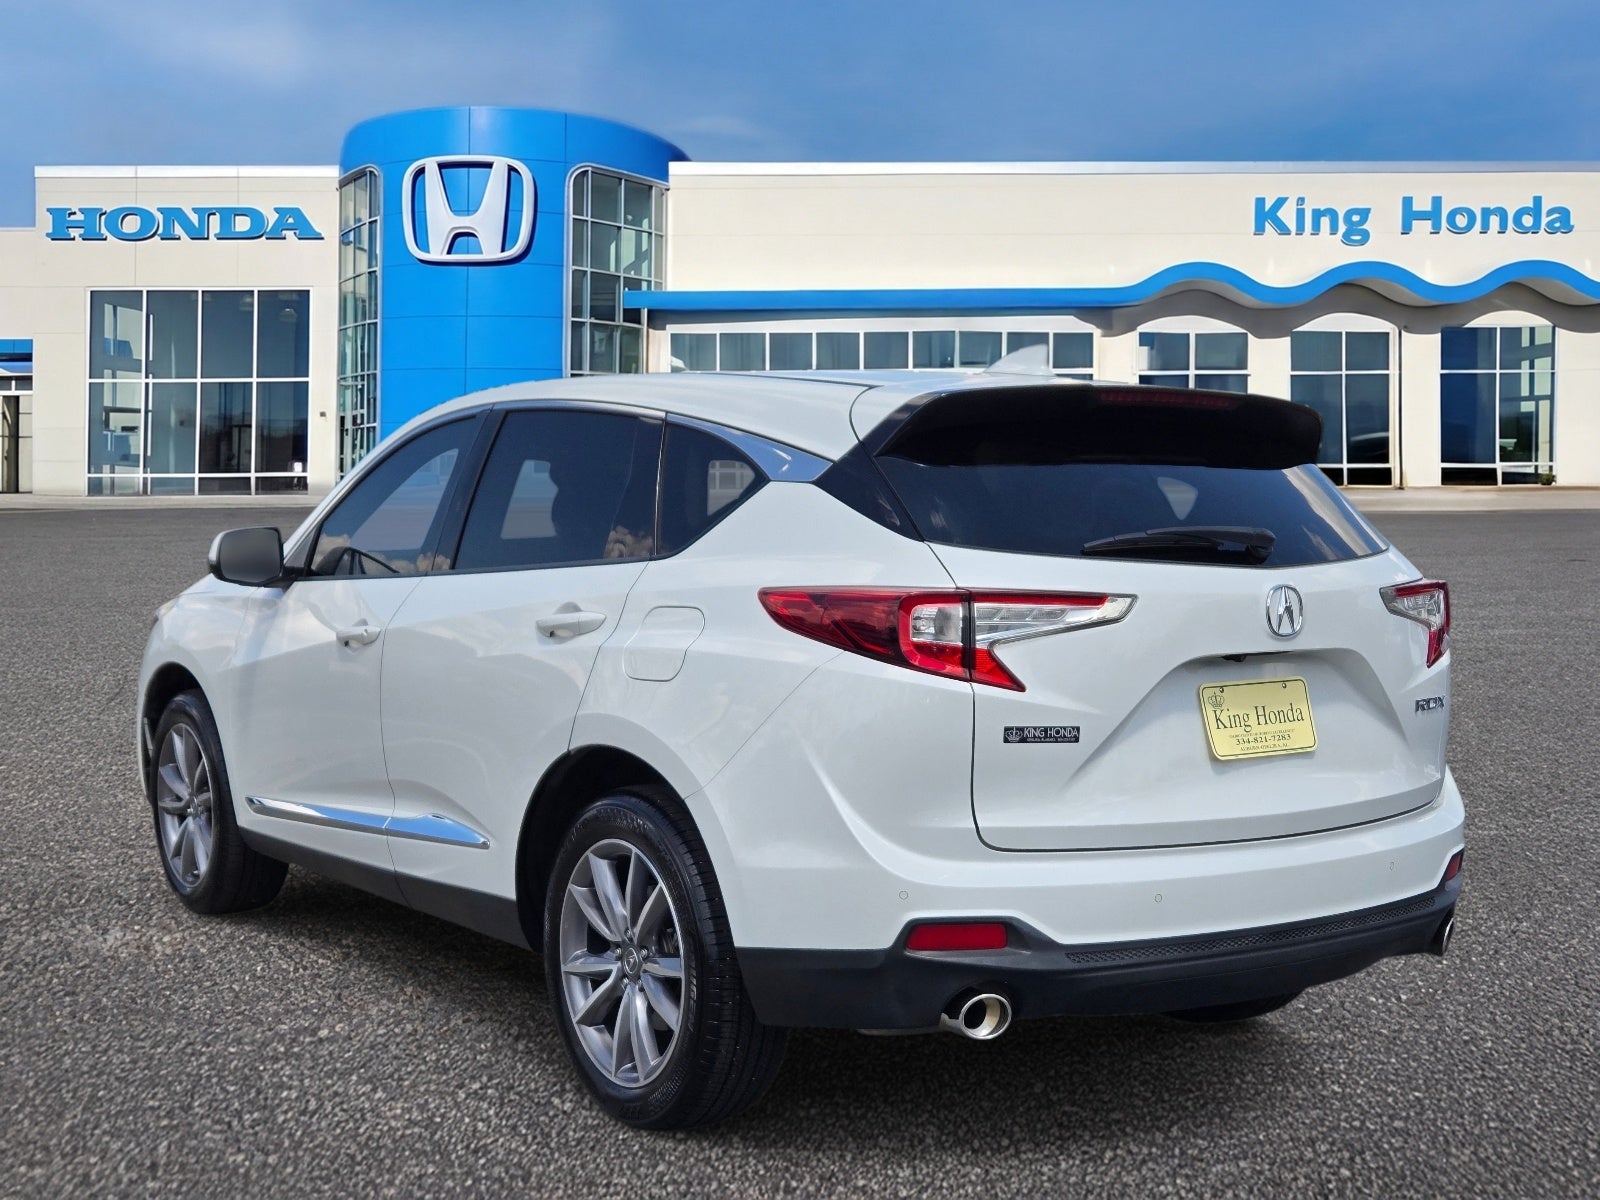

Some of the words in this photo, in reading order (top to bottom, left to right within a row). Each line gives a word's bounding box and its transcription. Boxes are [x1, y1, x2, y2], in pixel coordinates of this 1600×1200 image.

[46, 206, 324, 241] HONDA
[1253, 196, 1372, 246] King
[1400, 195, 1575, 235] Honda
[1023, 727, 1045, 738] KING
[1047, 727, 1079, 738] HONDA
[1212, 708, 1253, 733] King
[1254, 702, 1305, 726] Honda
[1235, 733, 1292, 746] 334-821-7283
